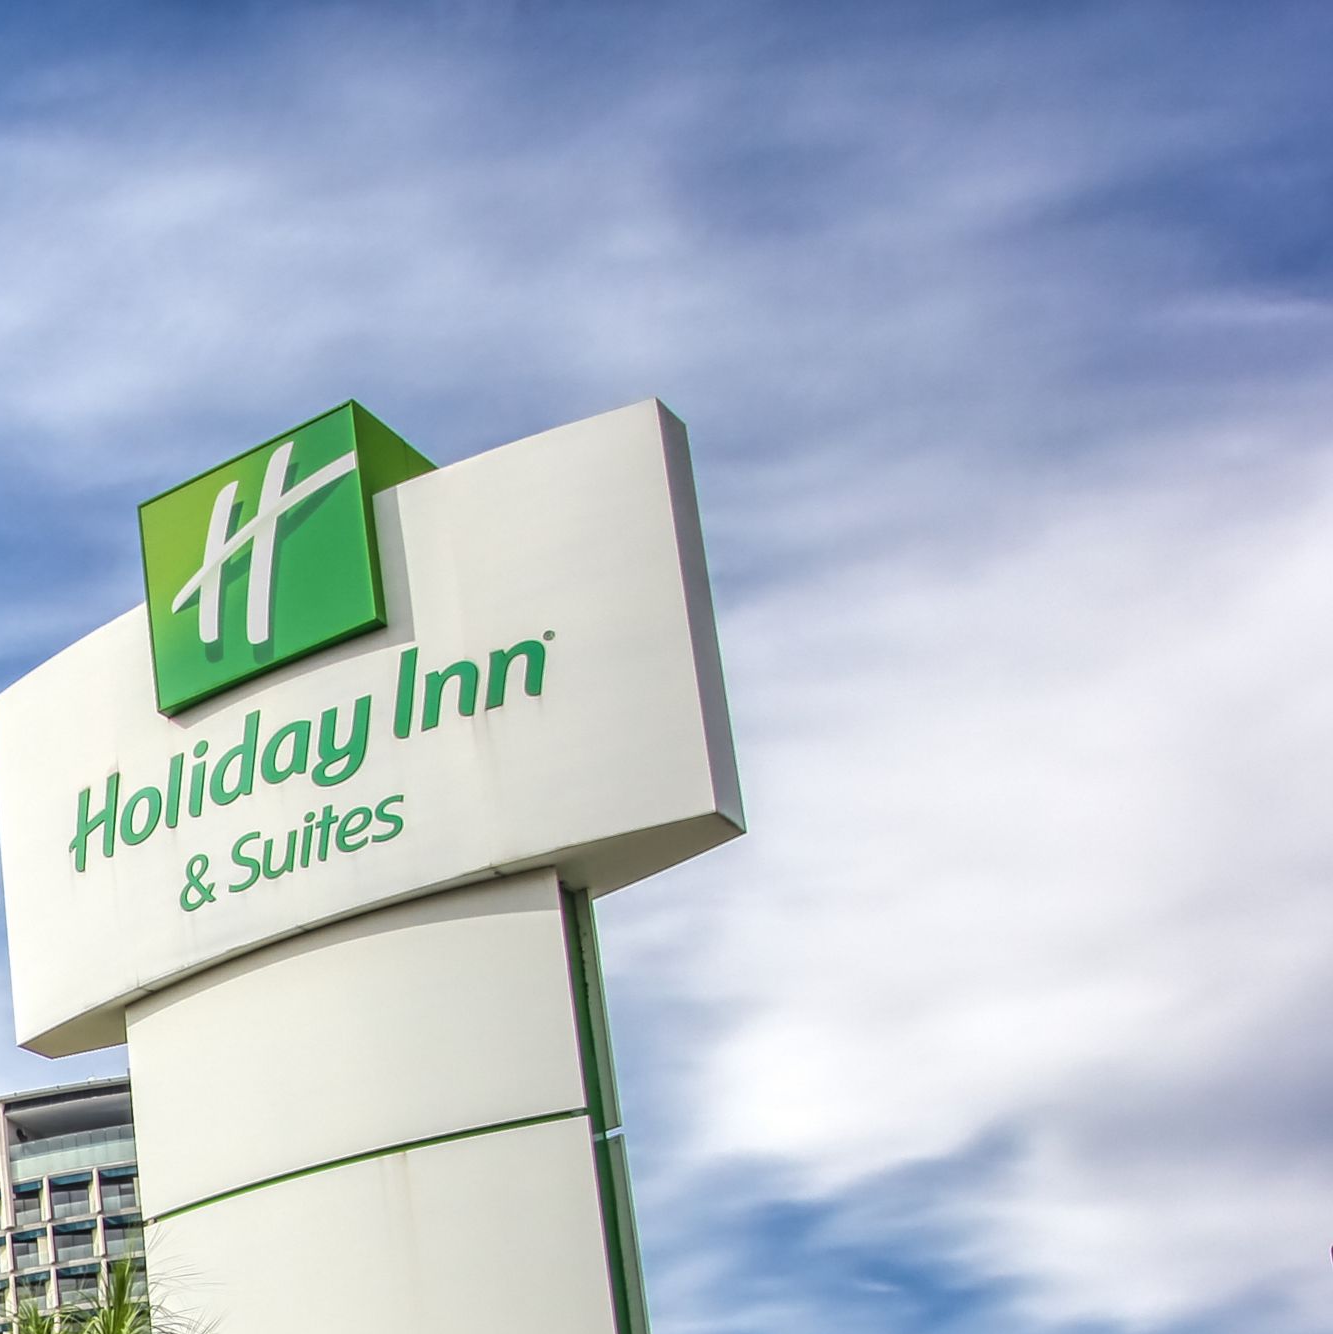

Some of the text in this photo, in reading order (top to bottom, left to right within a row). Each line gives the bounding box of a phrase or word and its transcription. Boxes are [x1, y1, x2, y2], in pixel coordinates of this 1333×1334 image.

[68, 637, 546, 874] Holiday Inn
[179, 793, 405, 913] & Suites
